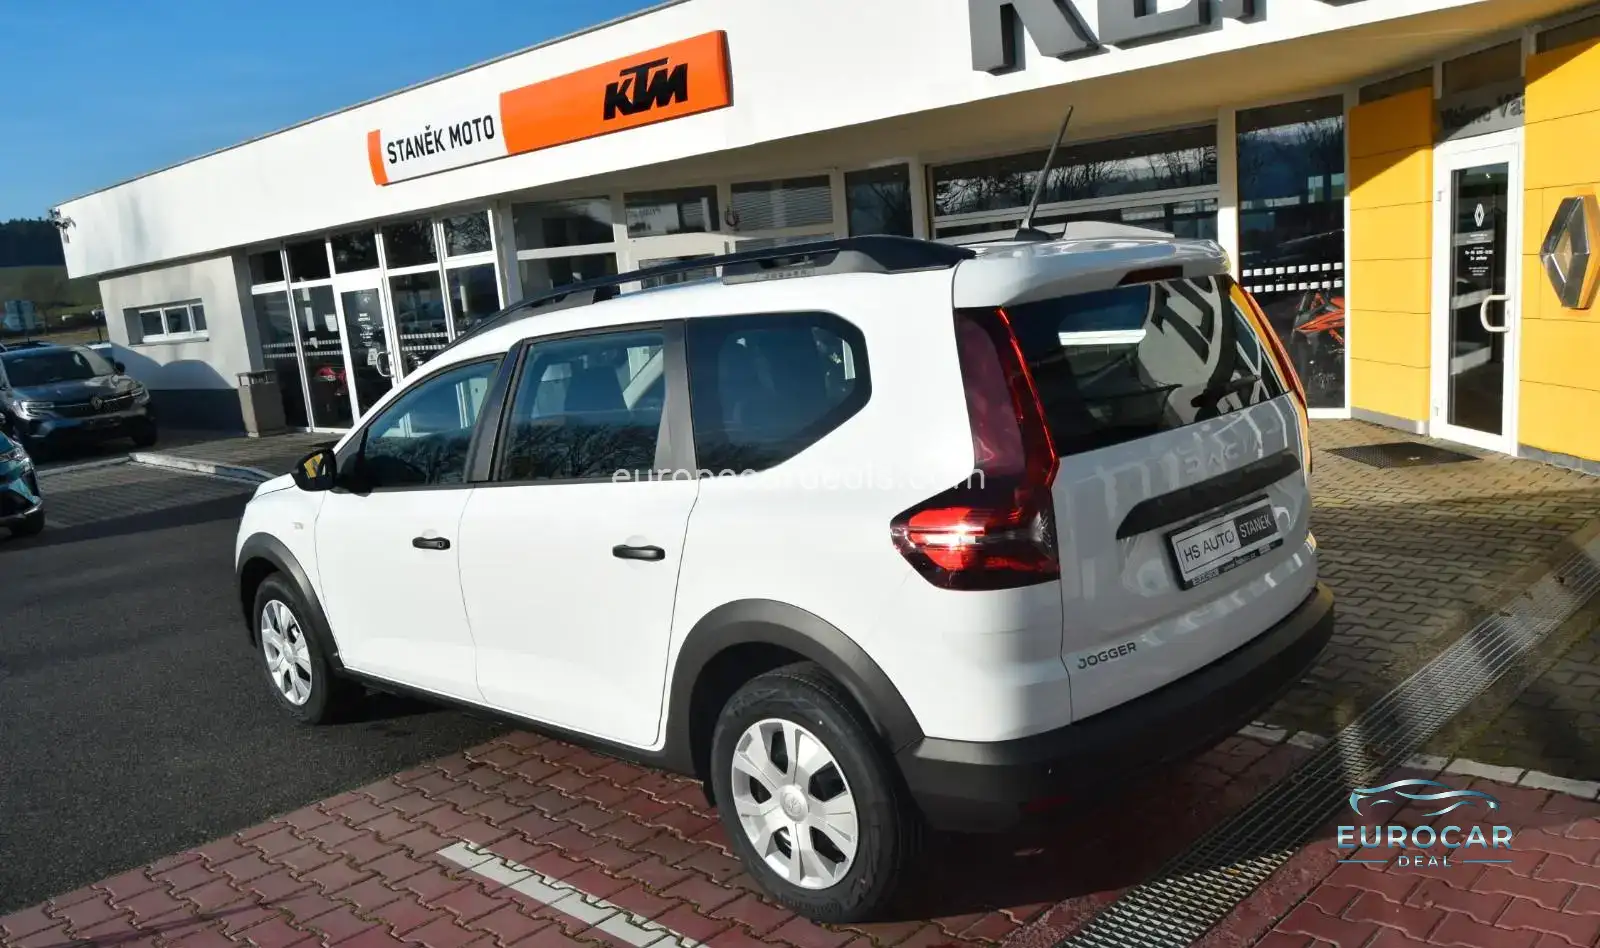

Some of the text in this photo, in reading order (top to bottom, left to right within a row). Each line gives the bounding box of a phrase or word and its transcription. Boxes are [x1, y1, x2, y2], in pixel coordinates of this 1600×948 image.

[603, 57, 689, 121] KTM
[387, 114, 495, 164] STANĚK MOTO
[1183, 544, 1201, 563] HS
[1203, 529, 1235, 555] AUTO
[1077, 642, 1137, 669] JOGGER
